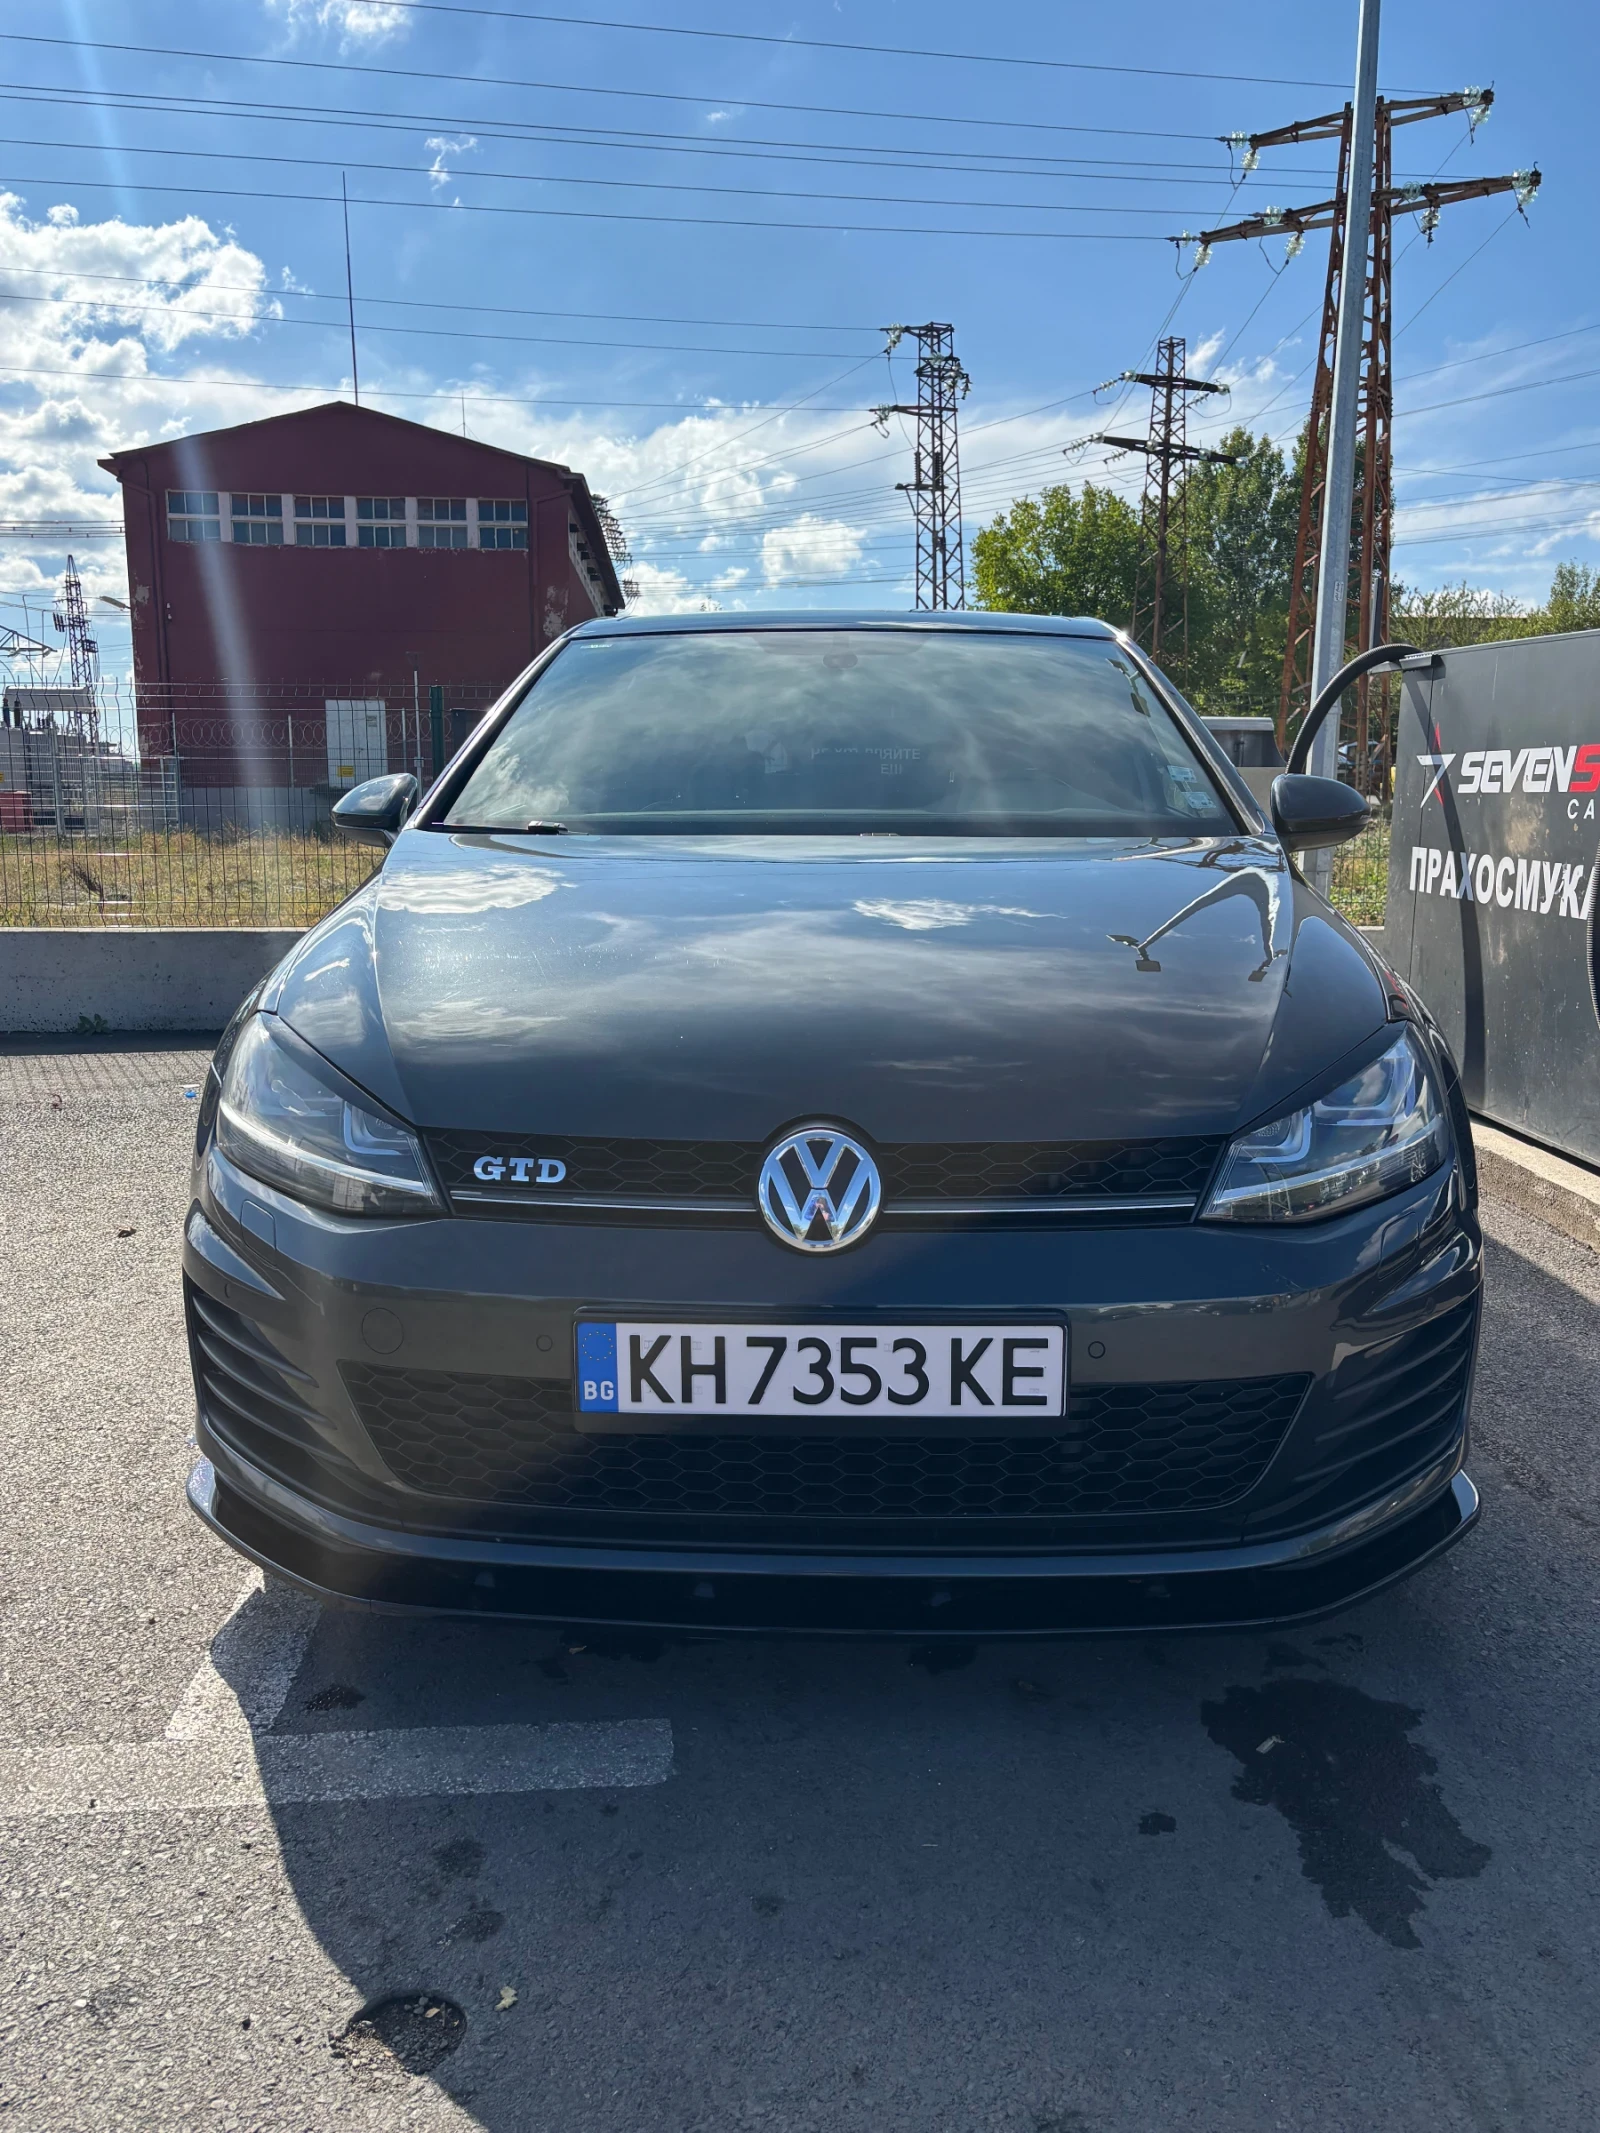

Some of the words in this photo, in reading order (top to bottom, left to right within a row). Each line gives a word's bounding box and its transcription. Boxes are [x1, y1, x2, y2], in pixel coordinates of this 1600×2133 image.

[473, 1155, 567, 1184] GTD
[629, 1334, 727, 1404] KH
[746, 1336, 931, 1406] 7353
[949, 1337, 1050, 1406] KE
[583, 1379, 615, 1401] BG
